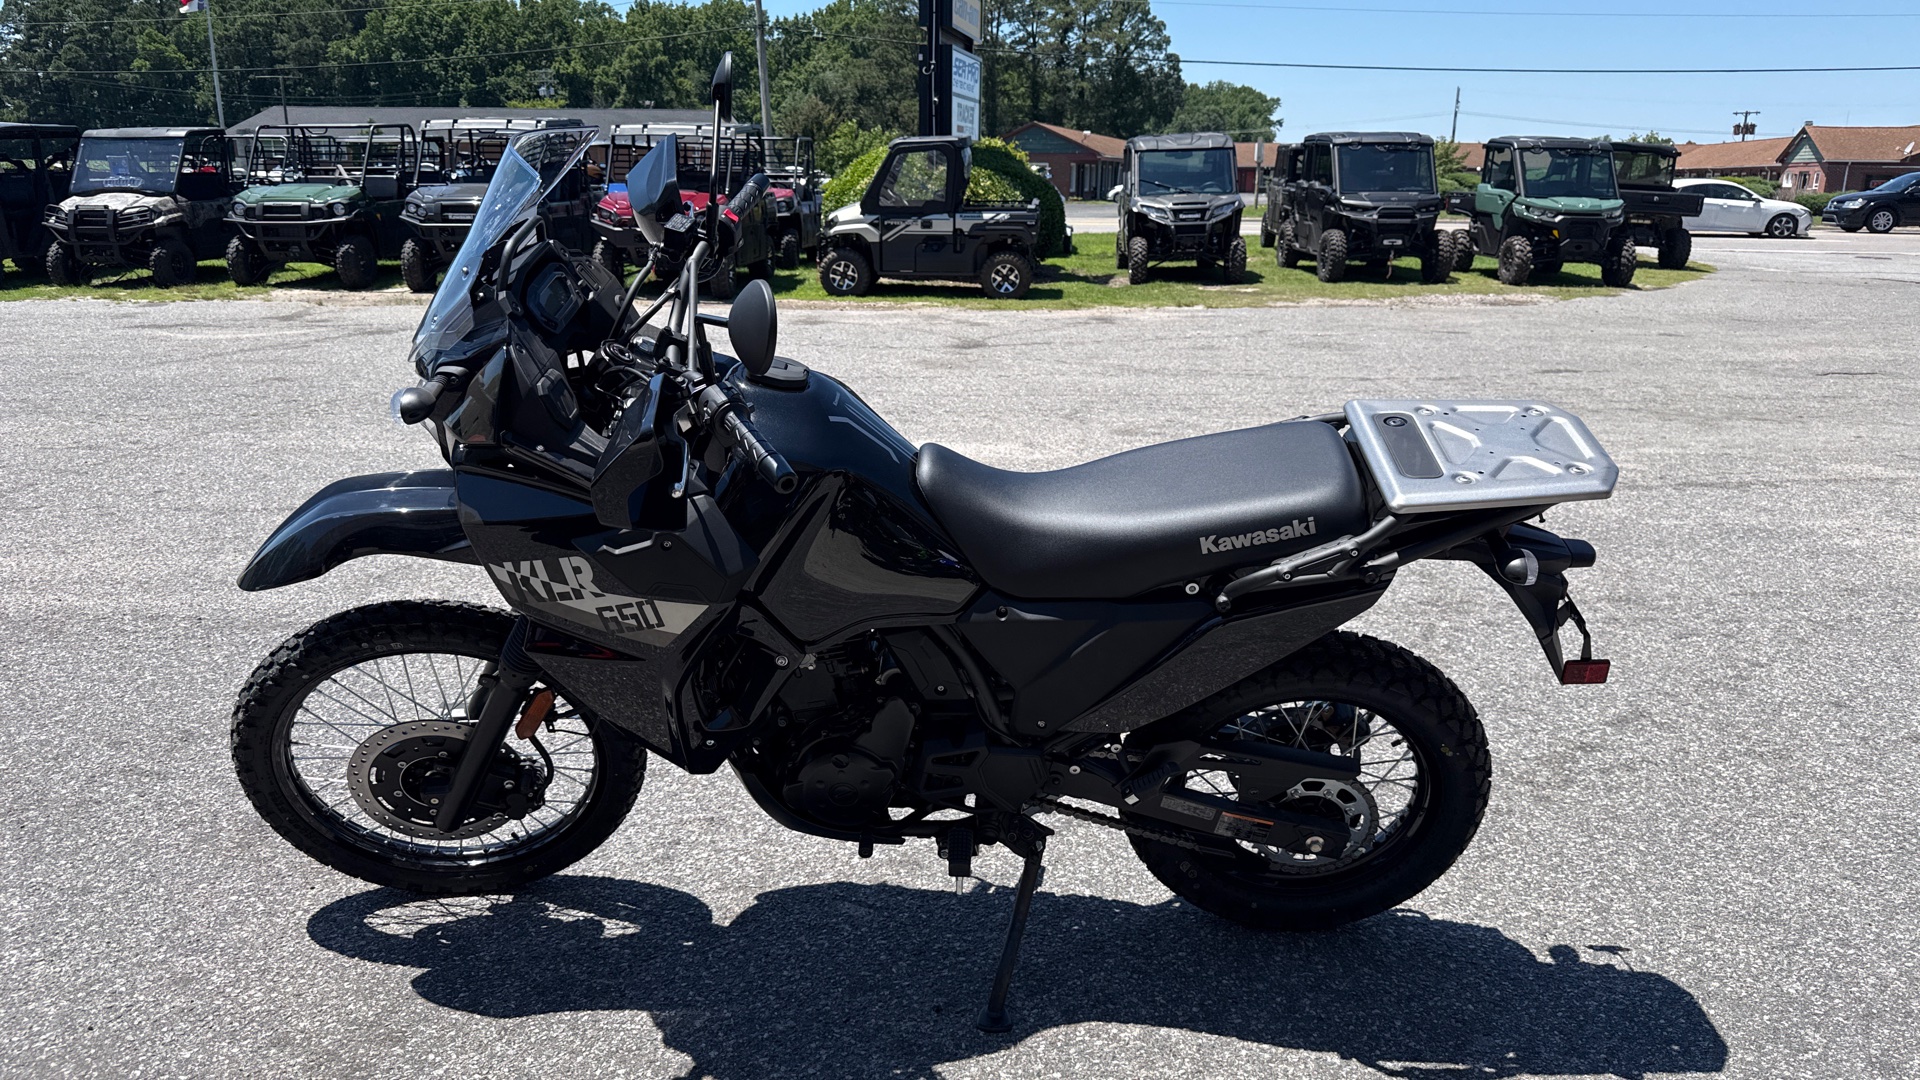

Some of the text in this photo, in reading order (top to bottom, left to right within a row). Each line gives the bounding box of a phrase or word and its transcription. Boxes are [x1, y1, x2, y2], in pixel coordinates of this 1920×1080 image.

[1199, 516, 1317, 555] Kawasaki
[502, 556, 606, 603] KLR
[595, 599, 666, 635] 650
